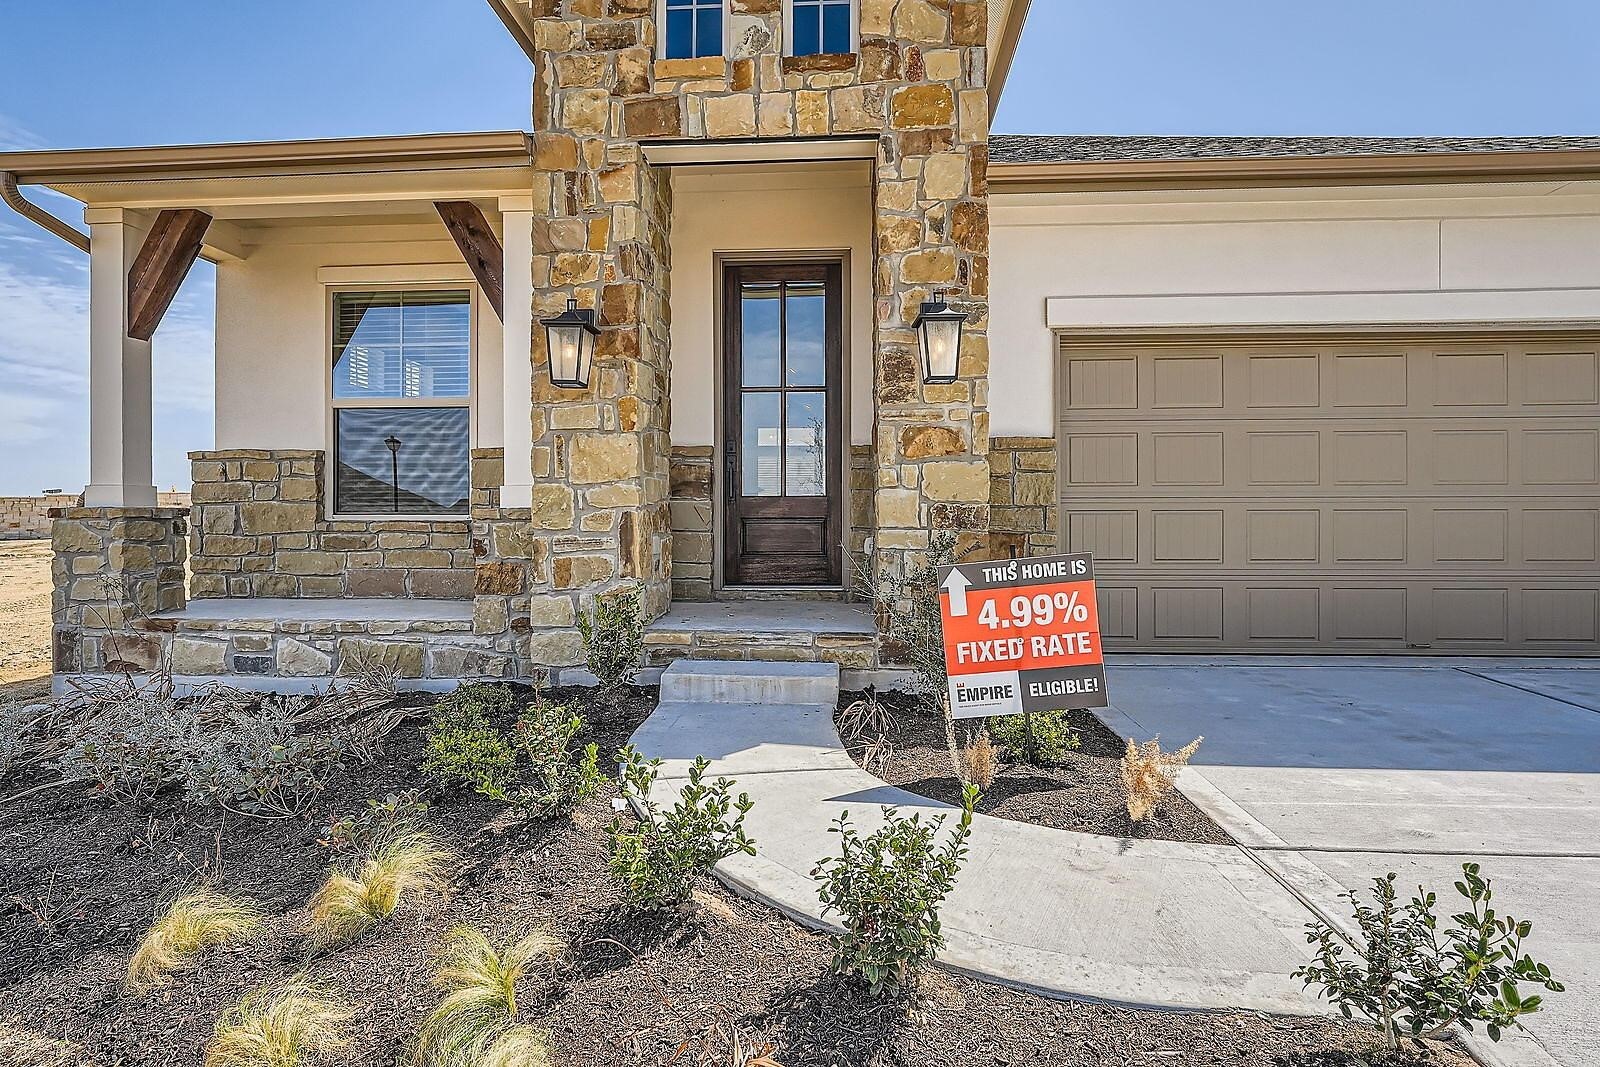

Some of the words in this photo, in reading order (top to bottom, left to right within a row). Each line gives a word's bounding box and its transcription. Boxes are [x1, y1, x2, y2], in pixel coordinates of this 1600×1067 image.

[982, 565, 1017, 583] THIS
[1021, 561, 1066, 579] HOME
[1072, 559, 1087, 575] IS
[978, 591, 1088, 629] 4.99%
[956, 638, 1024, 664] FIXED
[1031, 631, 1092, 658] RATE
[957, 685, 1014, 703] EMPIRE
[1029, 677, 1099, 697] ELIGIBLE!
